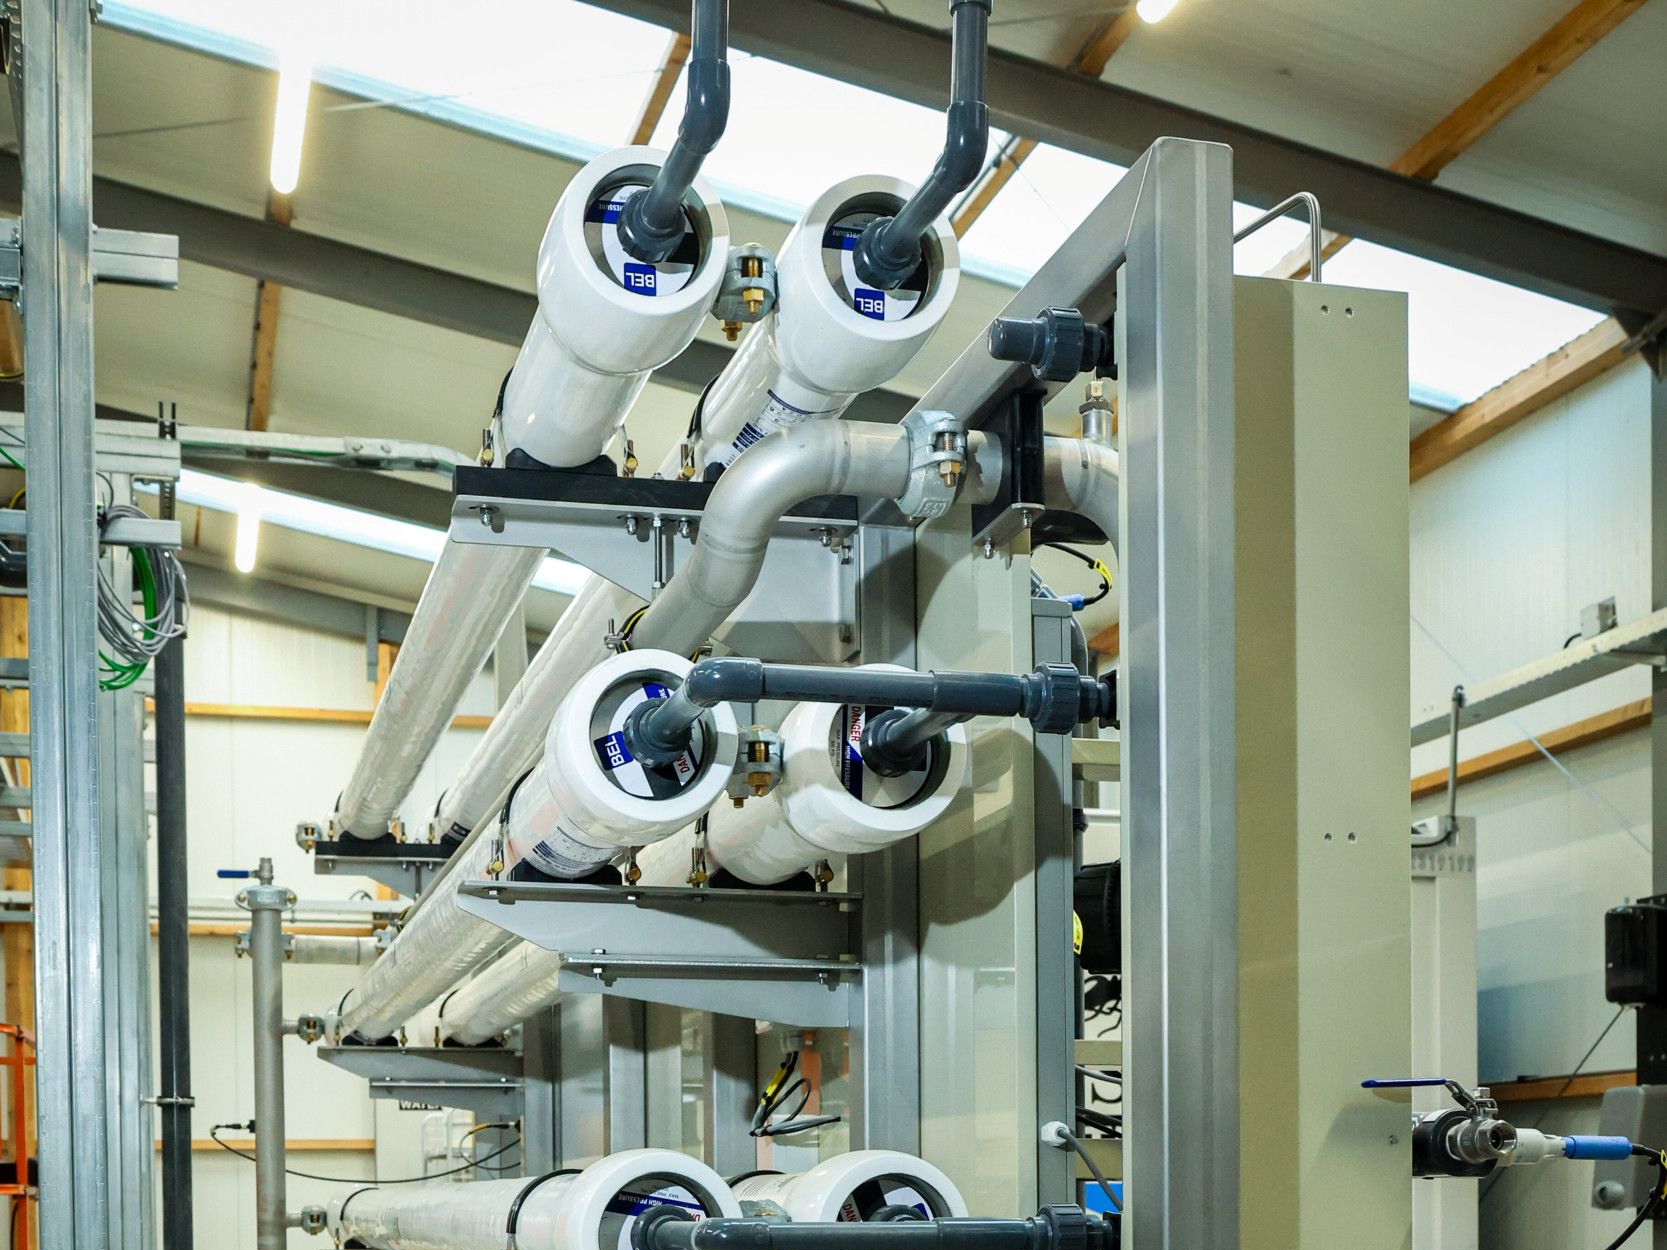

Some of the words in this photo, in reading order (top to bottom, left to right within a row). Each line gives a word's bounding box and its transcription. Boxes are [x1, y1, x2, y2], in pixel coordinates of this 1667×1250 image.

[626, 272, 655, 288] BEL
[856, 297, 884, 313] BEL
[850, 705, 861, 742] DANGER
[604, 734, 627, 767] BEL
